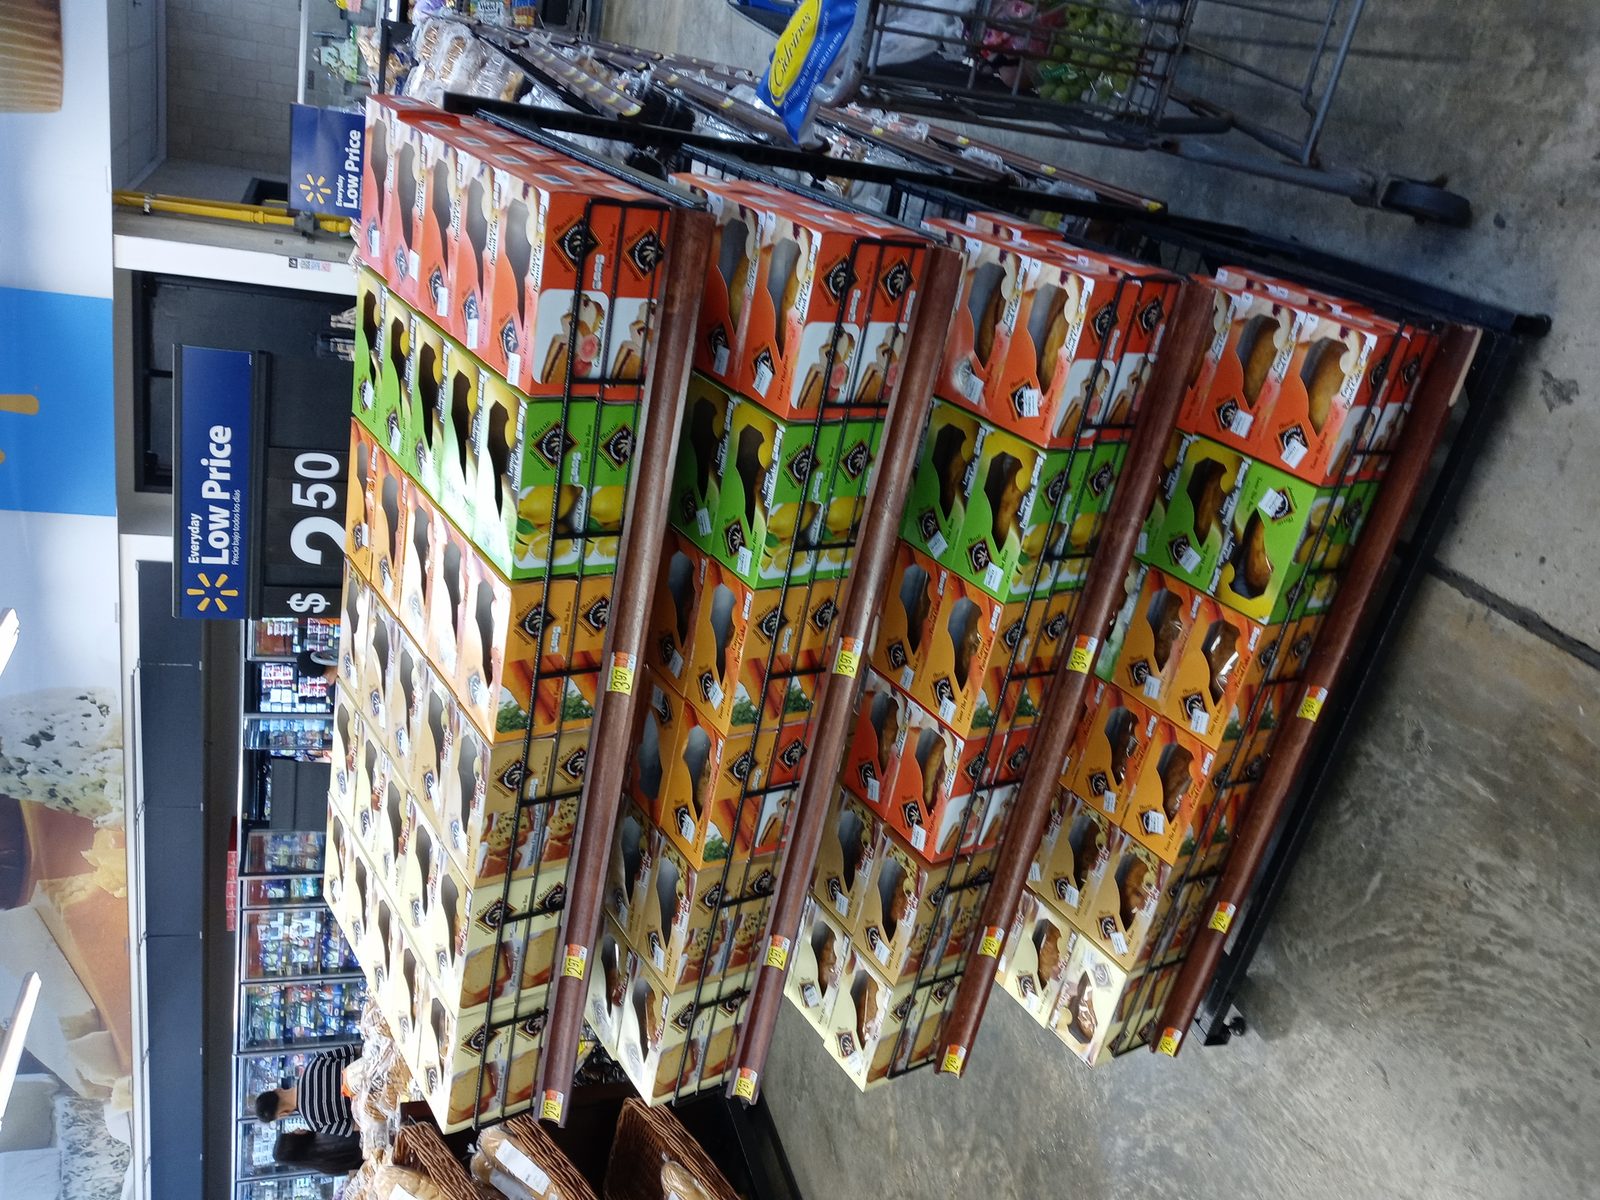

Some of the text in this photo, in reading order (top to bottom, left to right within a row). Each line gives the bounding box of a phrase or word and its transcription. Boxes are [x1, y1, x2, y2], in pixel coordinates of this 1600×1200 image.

[342, 130, 361, 209] Low Price
[336, 175, 345, 207] Everyday
[507, 452, 515, 476] Lemon
[512, 443, 522, 491] Pound Cake
[200, 425, 232, 564] Low Price
[761, 472, 769, 494] Lemon
[764, 464, 777, 508] Pound Cake
[232, 503, 240, 512] los
[232, 513, 240, 531] todos
[188, 512, 203, 564] Everyday
[232, 532, 242, 546] bajo
[286, 452, 346, 613] $ 2 50
[231, 546, 240, 565] Precio
